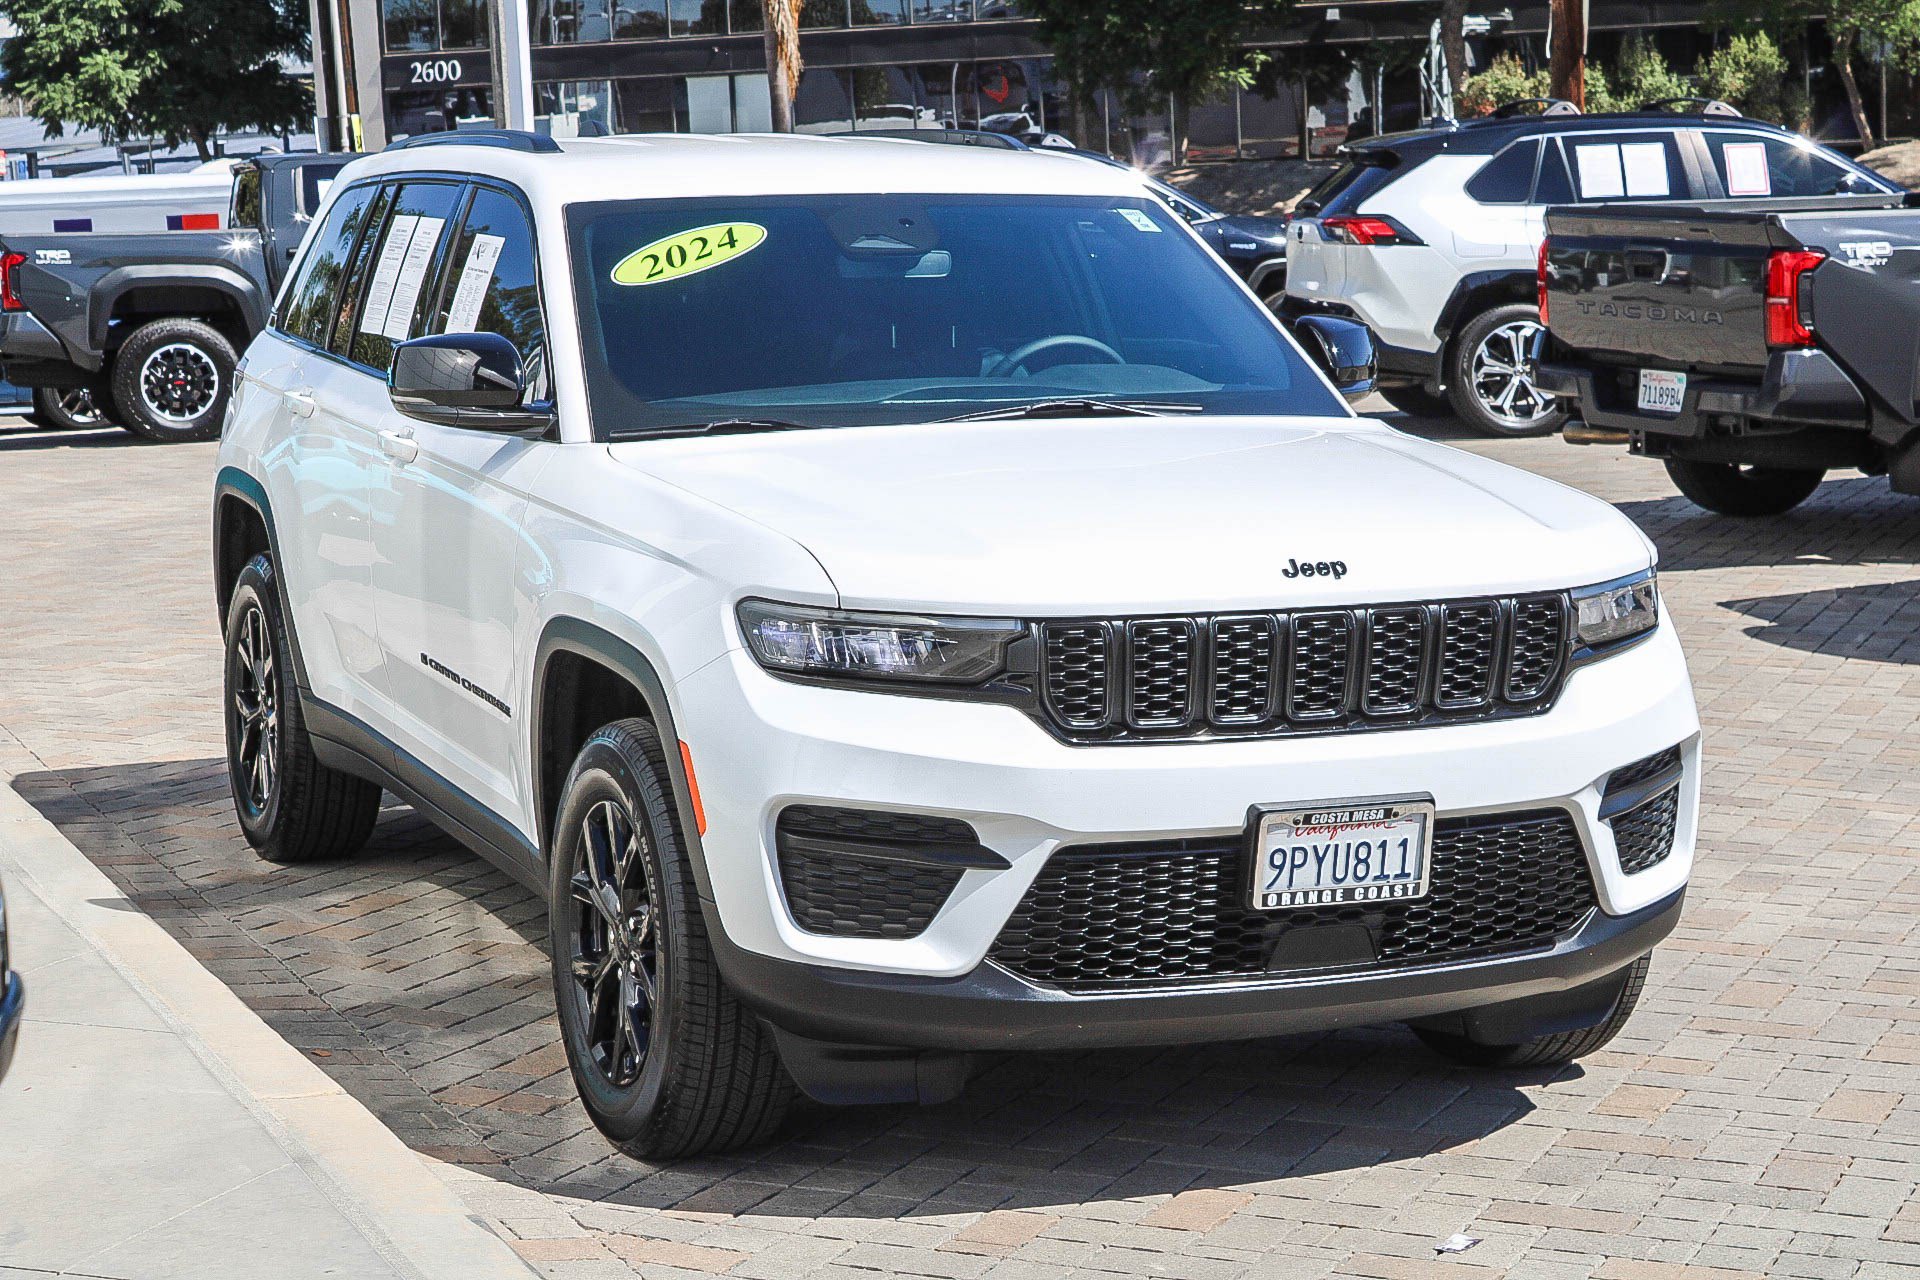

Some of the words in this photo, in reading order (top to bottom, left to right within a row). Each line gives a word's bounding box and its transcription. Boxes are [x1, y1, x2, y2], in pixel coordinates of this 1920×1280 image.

[410, 59, 462, 83] 2600
[35, 249, 71, 261] TRD
[640, 226, 739, 280] 2024
[1839, 241, 1894, 259] TRD
[1576, 301, 1724, 325] TACOMA
[1642, 384, 1681, 406] 71189B4
[1281, 558, 1348, 580] Jeep
[1310, 812, 1350, 825] COSTA
[1351, 809, 1385, 822] MESA
[1265, 837, 1413, 890] 9PYU811
[640, 836, 662, 946] MICHELIN
[1266, 888, 1345, 907] ORANGE
[1354, 883, 1416, 900] COAST
